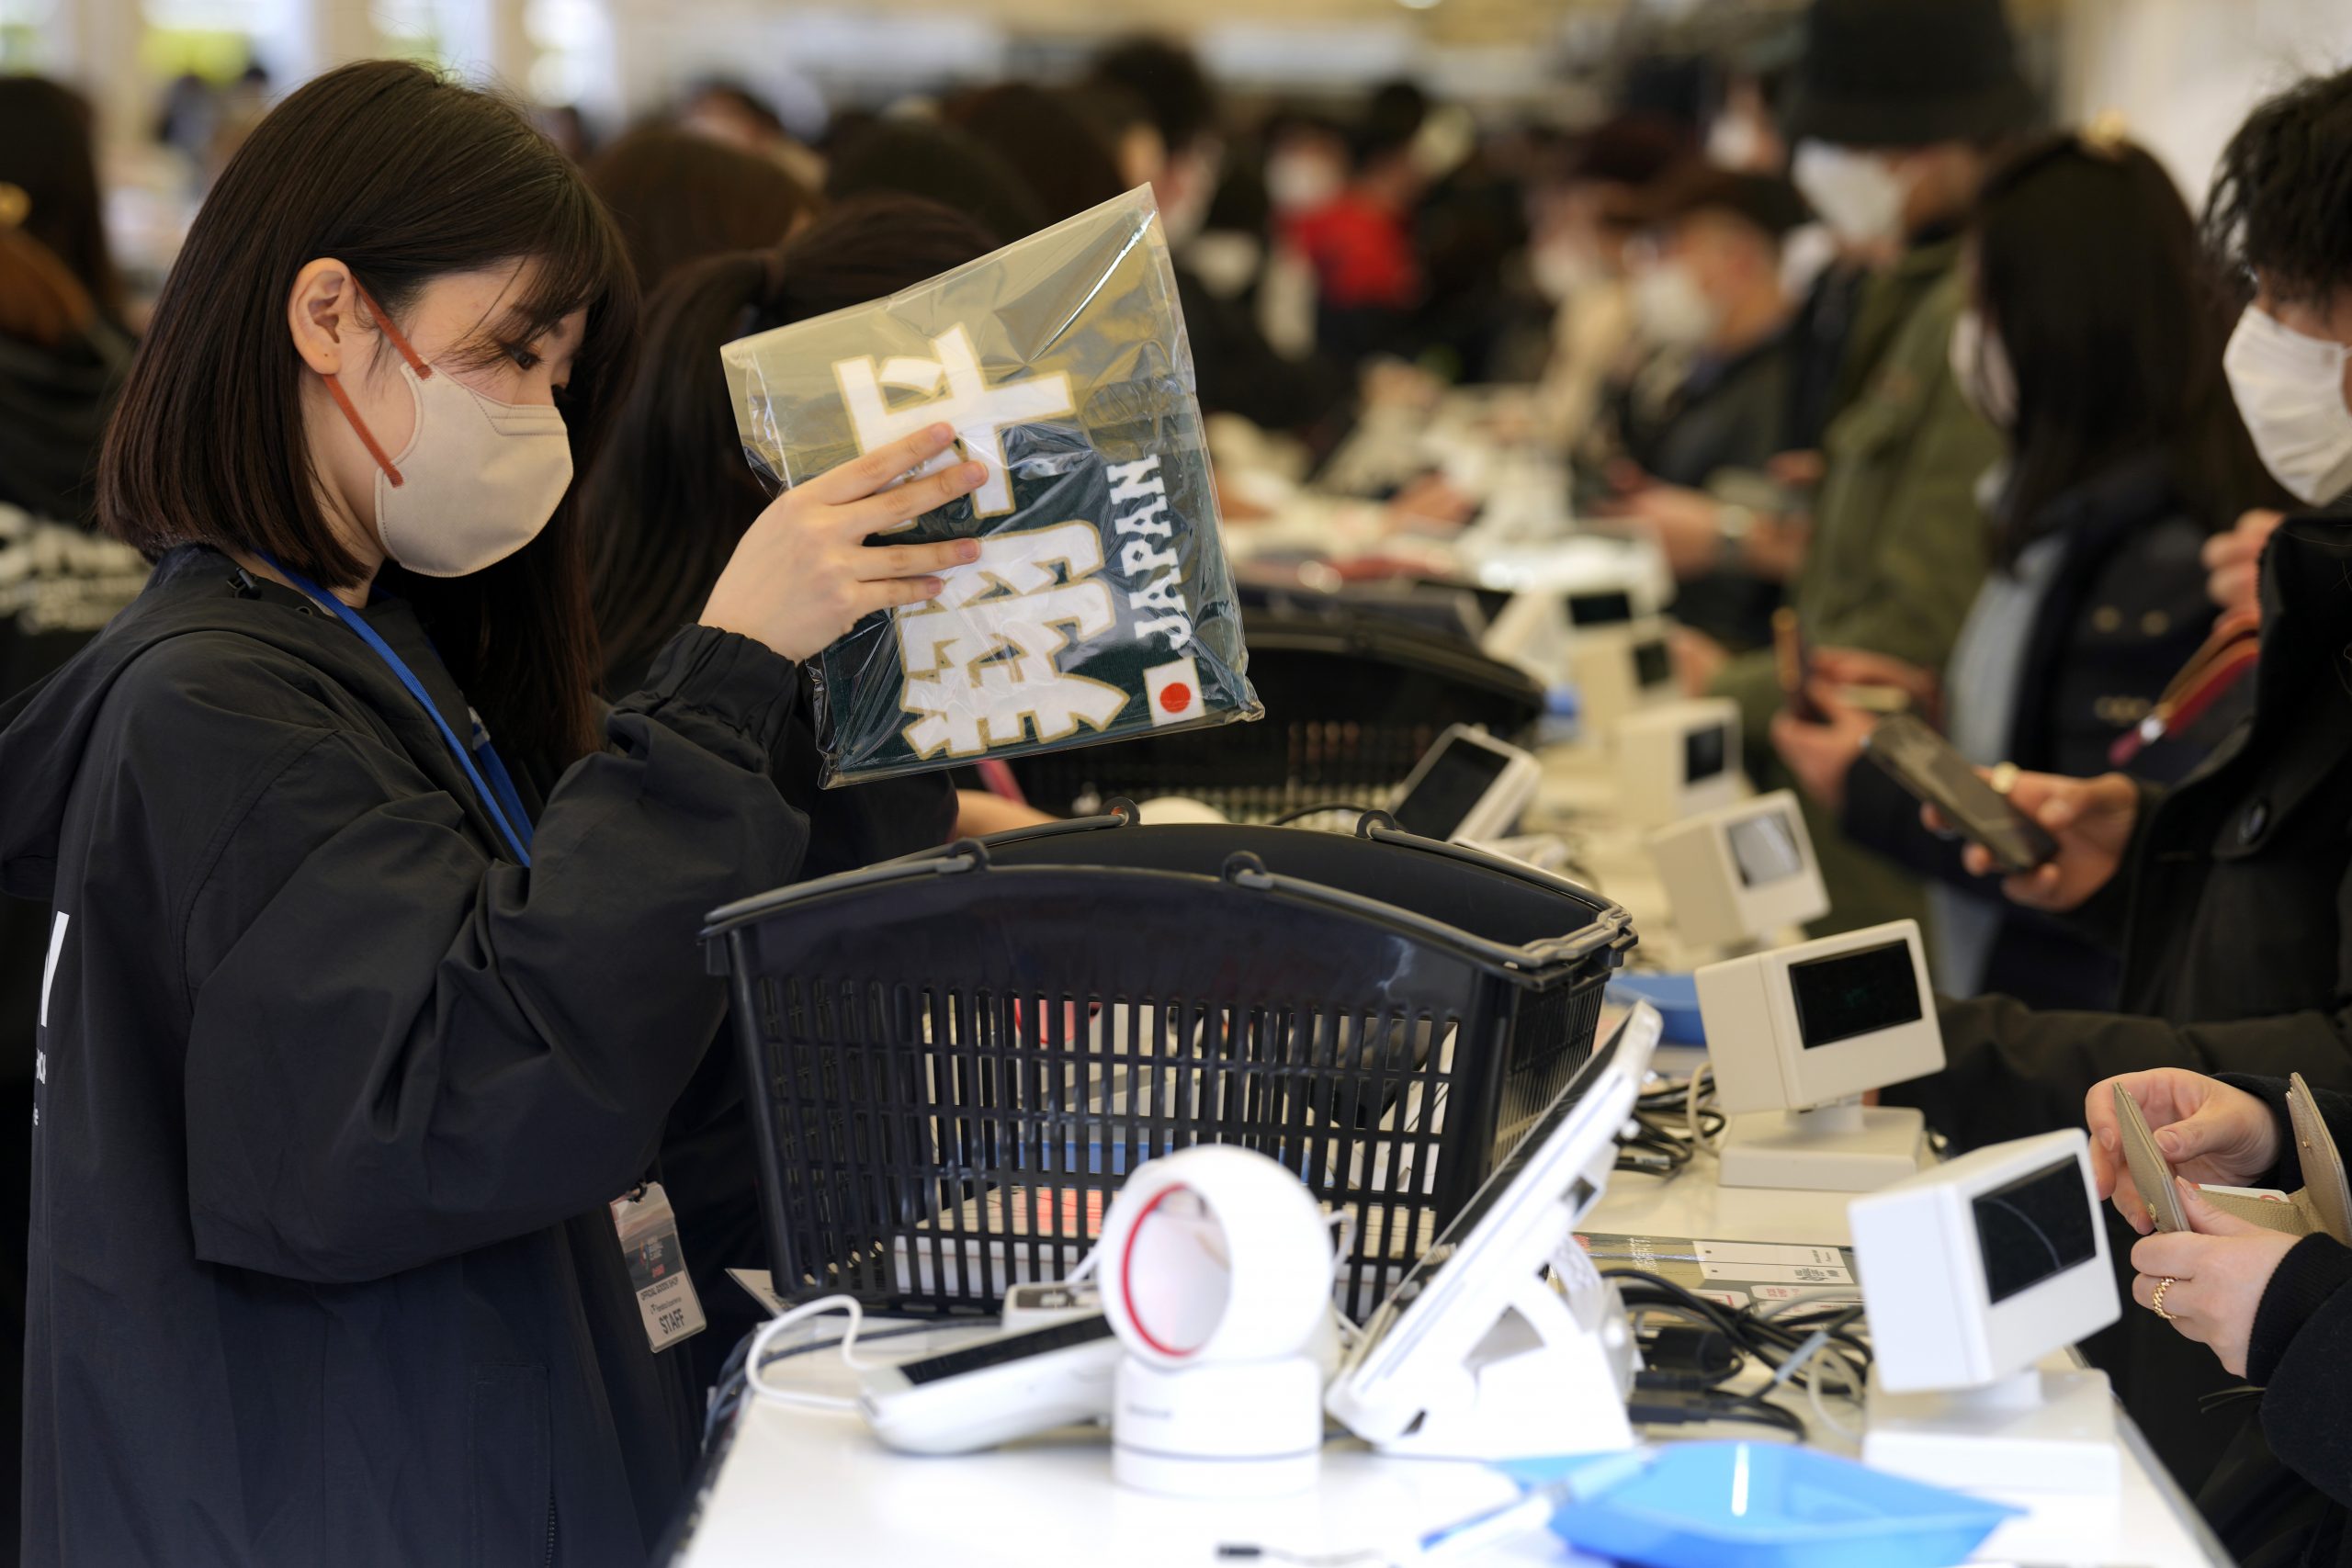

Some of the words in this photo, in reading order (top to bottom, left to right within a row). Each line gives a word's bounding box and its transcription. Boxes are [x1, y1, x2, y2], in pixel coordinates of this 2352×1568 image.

[834, 324, 1130, 760] 翔平
[1106, 453, 1193, 650] JAPAN
[659, 1308, 684, 1335] STAFF
